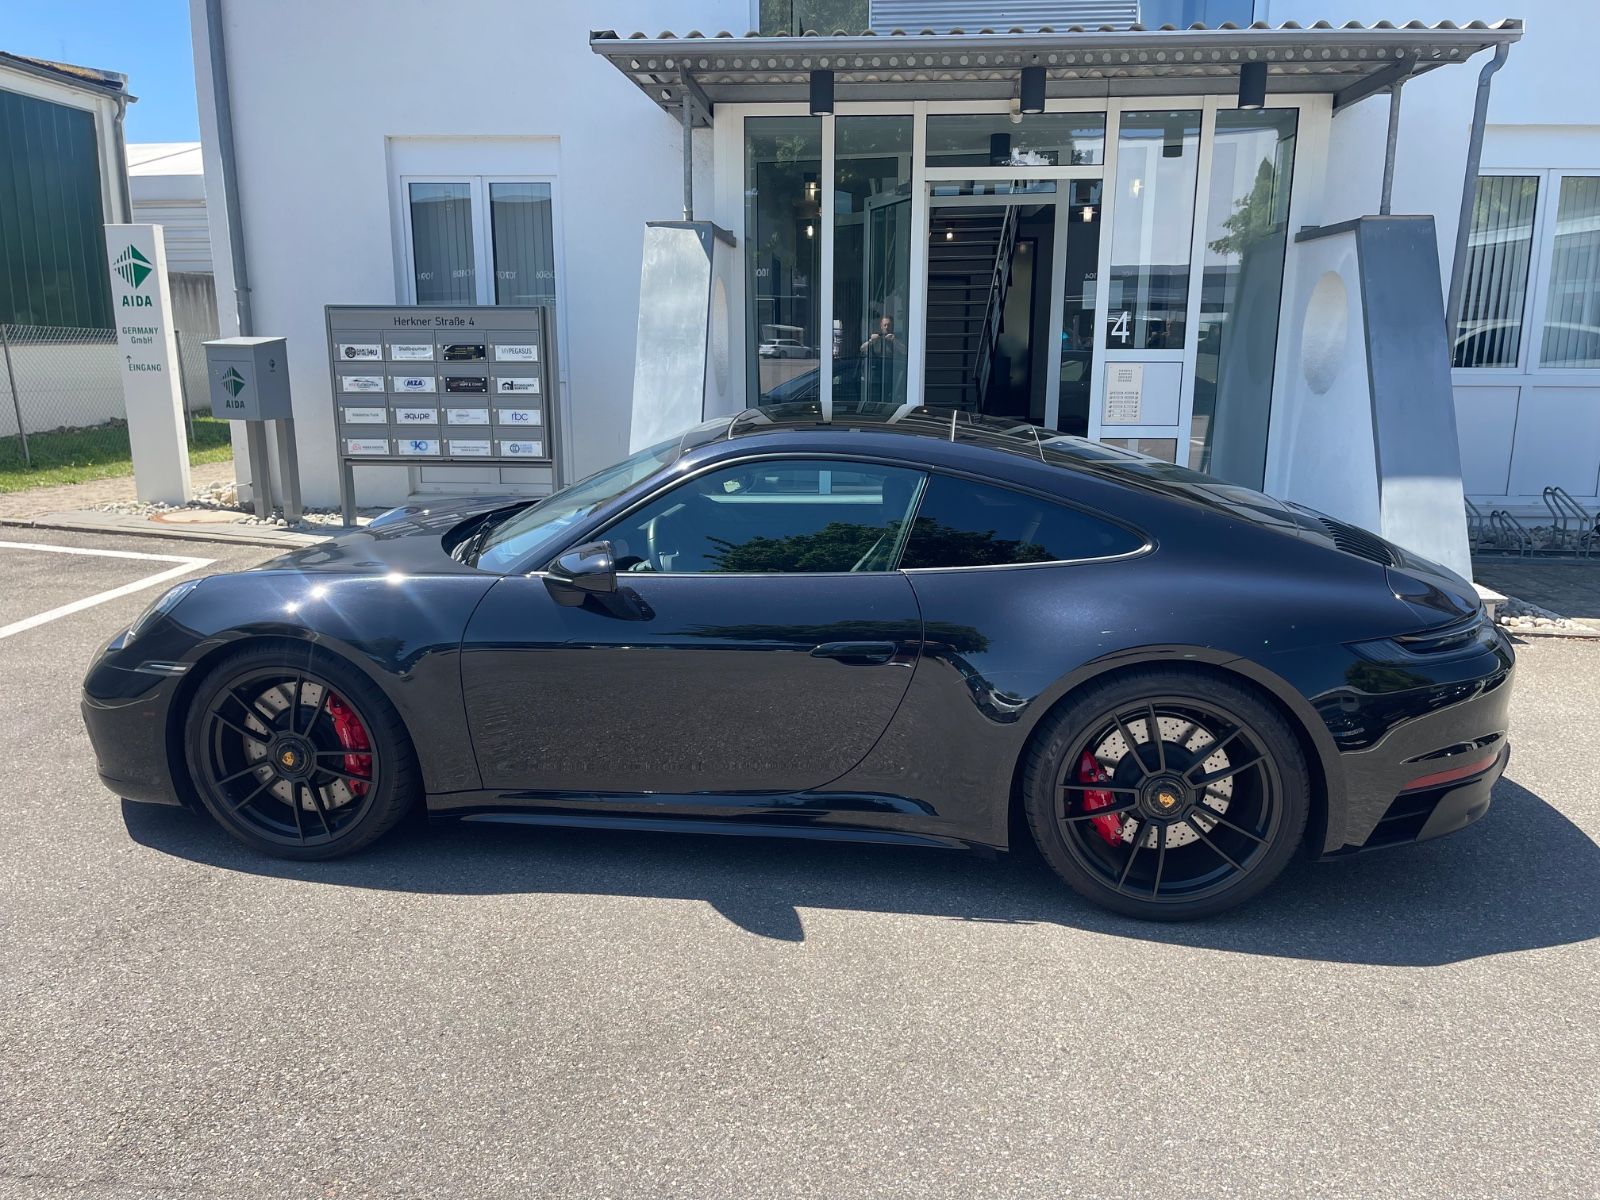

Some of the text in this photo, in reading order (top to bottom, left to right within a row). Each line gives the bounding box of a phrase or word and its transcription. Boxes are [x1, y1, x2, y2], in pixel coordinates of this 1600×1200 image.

[122, 295, 153, 307] AIDA
[393, 316, 475, 326] Herkner Straße 4
[122, 326, 159, 335] GERMANY
[1111, 310, 1130, 344] 4
[131, 336, 153, 344] GmbH
[128, 363, 162, 372] EINGANG
[406, 379, 423, 387] MZA
[225, 399, 246, 409] AIDA
[511, 411, 529, 421] rbc
